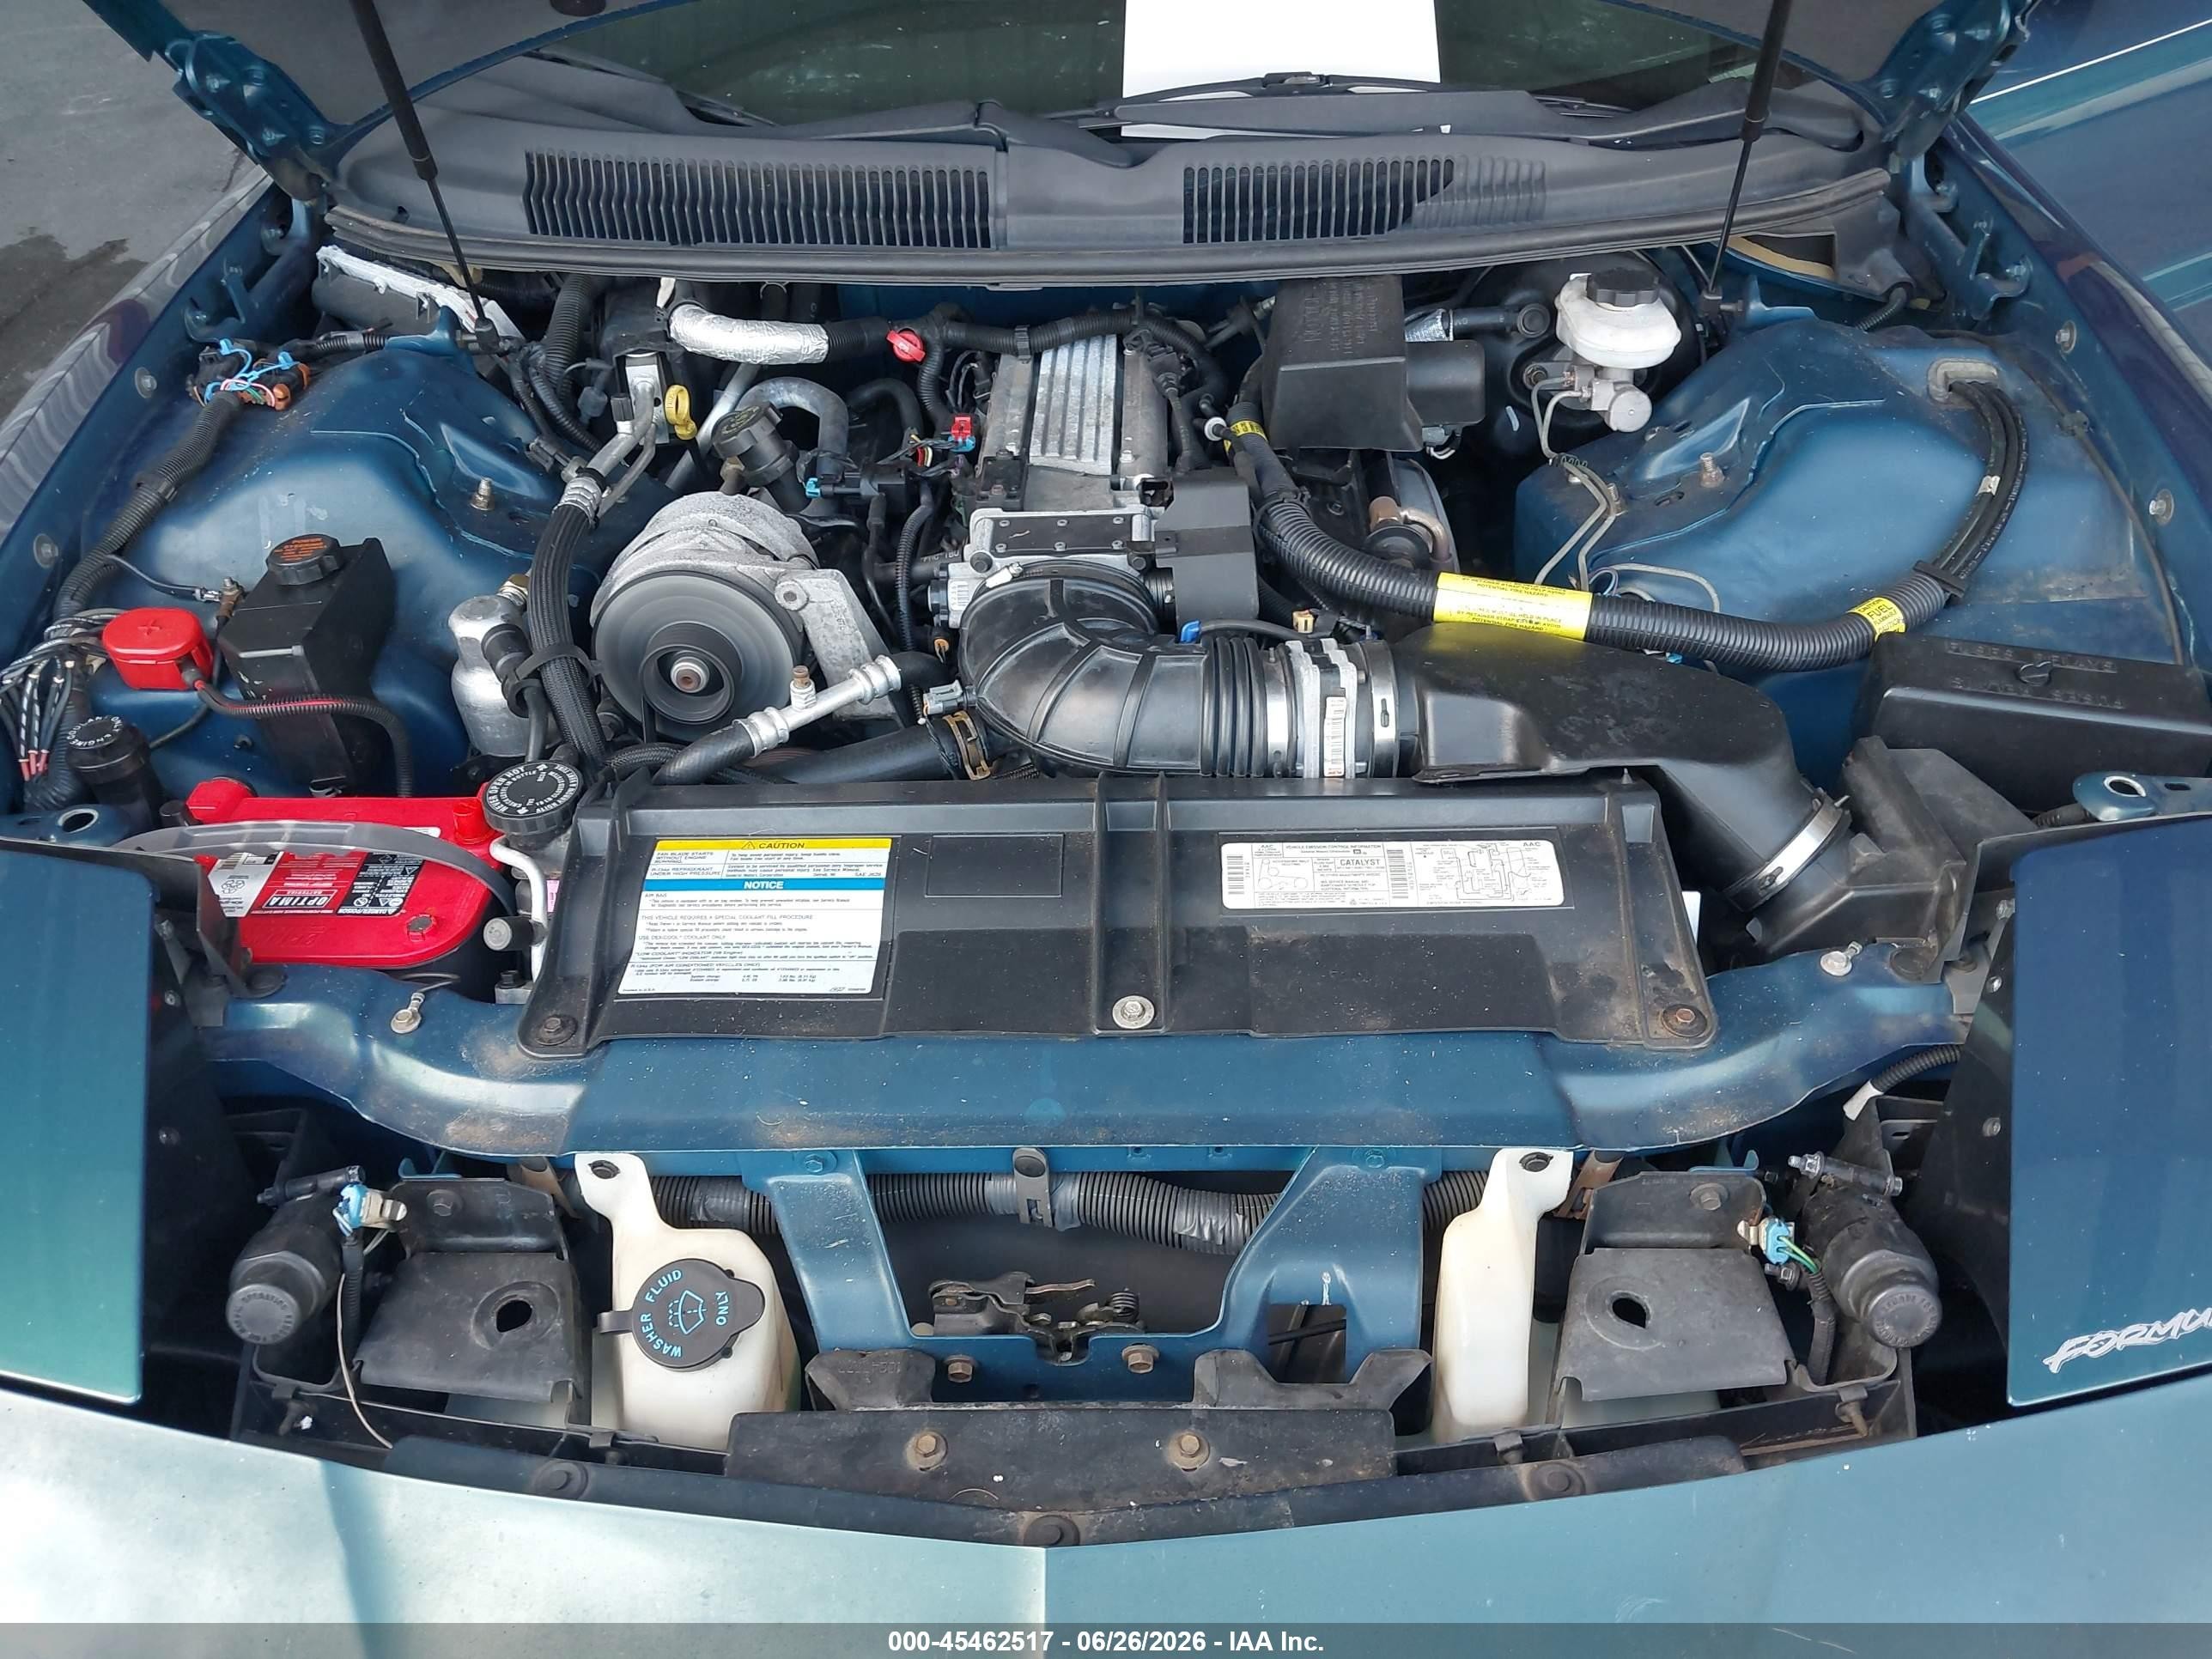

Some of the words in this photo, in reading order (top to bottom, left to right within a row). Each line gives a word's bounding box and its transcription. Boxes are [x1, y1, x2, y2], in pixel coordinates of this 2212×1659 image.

[1867, 604, 1893, 619] FUEL
[1472, 617, 1503, 626] POTENTIAL
[111, 716, 123, 733] ONLY
[504, 766, 526, 778] HOT
[510, 769, 538, 781] BOTTLE
[488, 776, 507, 794] OPEN
[488, 794, 509, 812] NEVER
[535, 801, 558, 814] ALIGN
[744, 880, 785, 890] NOTICE
[269, 896, 332, 907] OPTIMA
[645, 1269, 683, 1303] FLUID
[714, 1291, 729, 1326] ONLY
[640, 1312, 683, 1358] WASHER
[2042, 1307, 2212, 1374] FORMU
